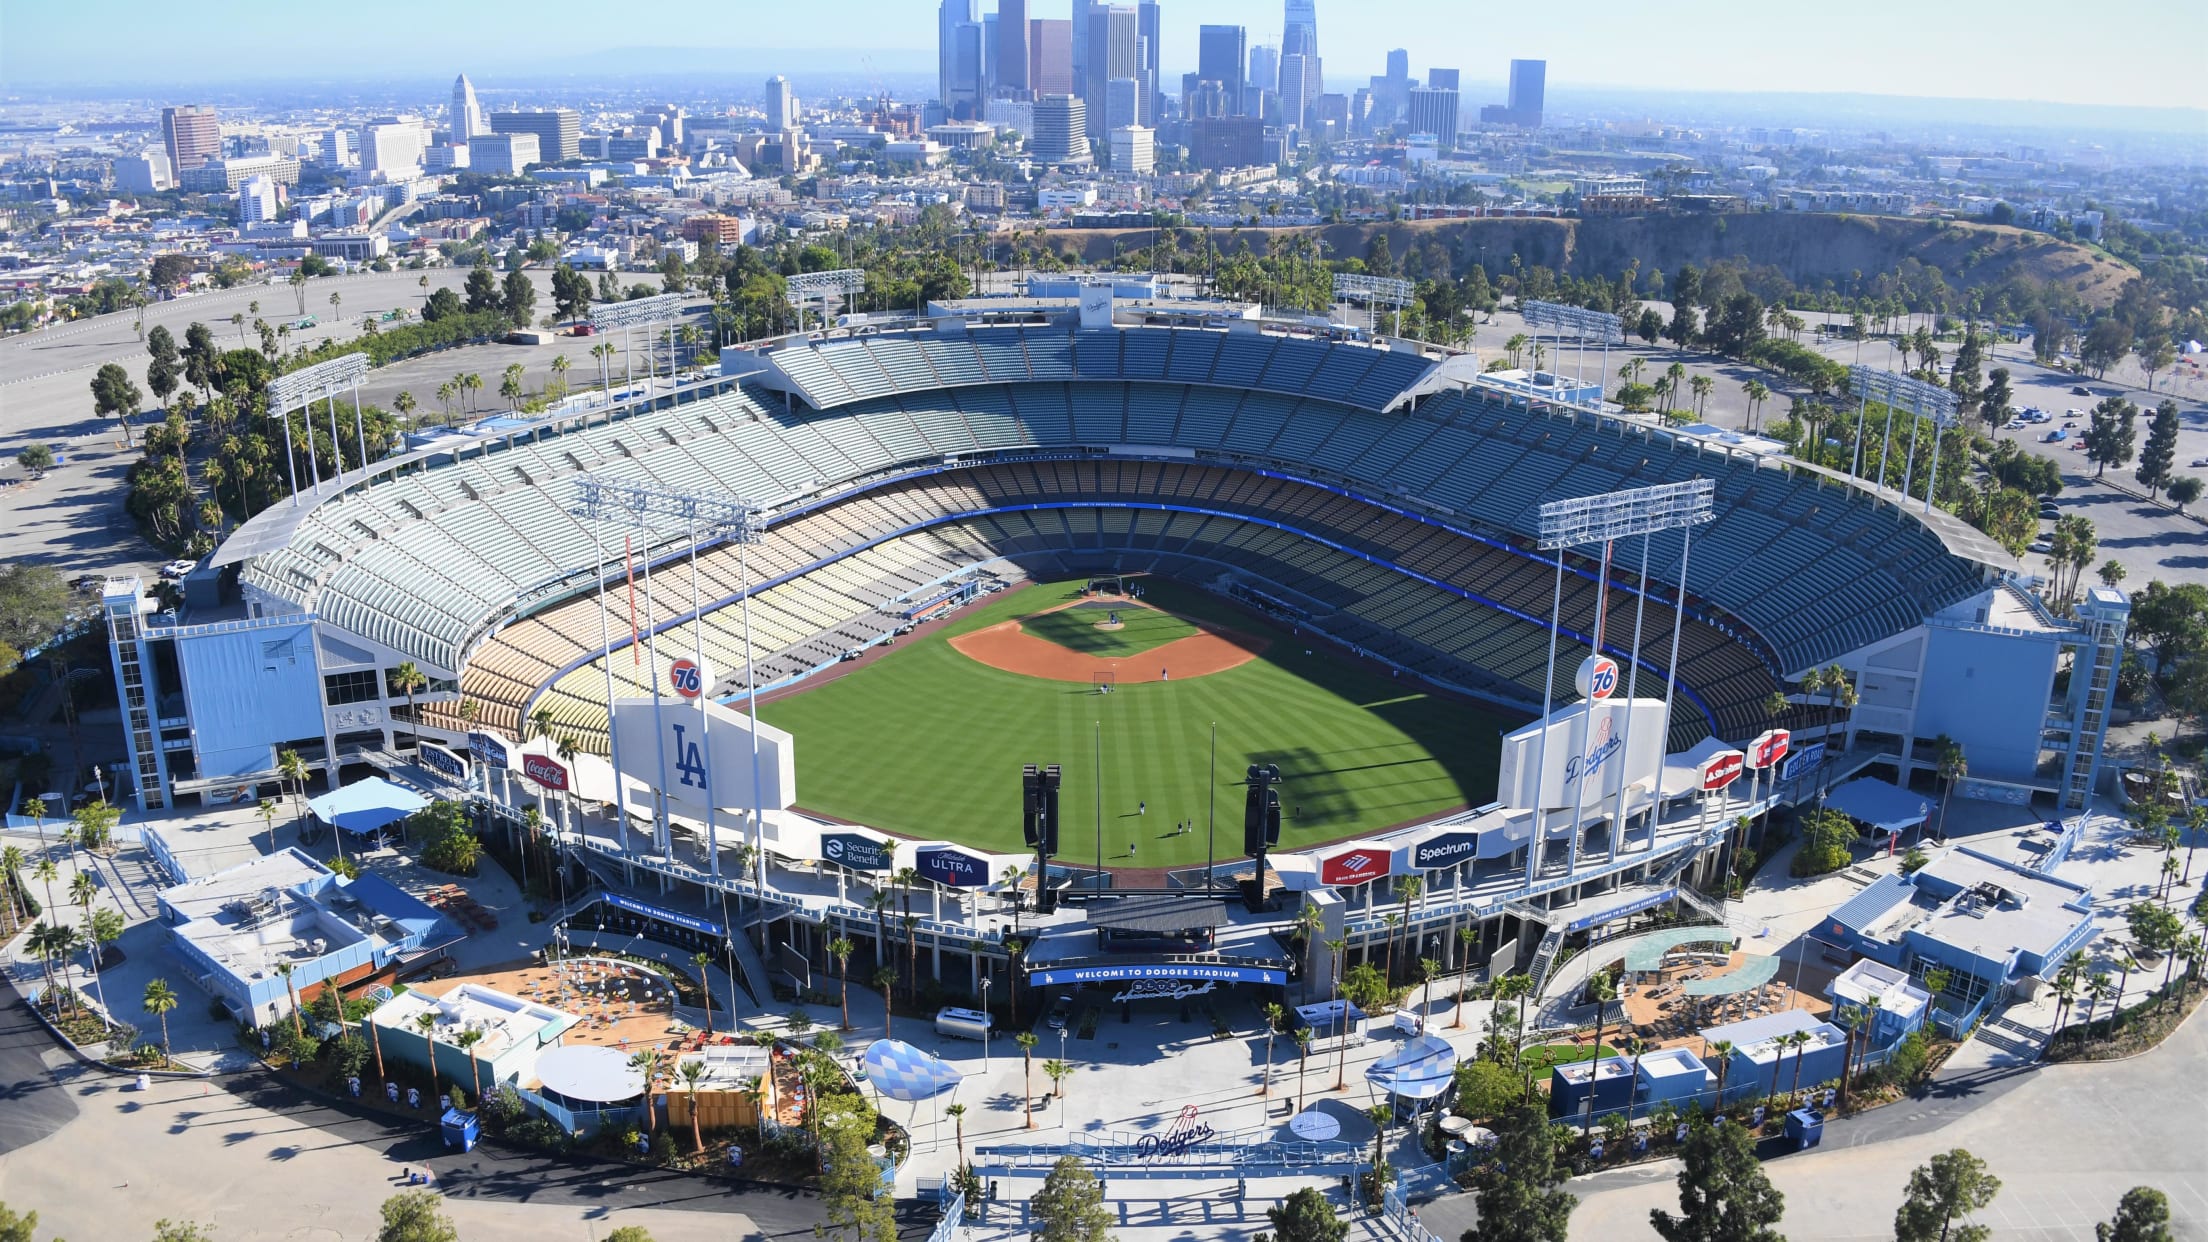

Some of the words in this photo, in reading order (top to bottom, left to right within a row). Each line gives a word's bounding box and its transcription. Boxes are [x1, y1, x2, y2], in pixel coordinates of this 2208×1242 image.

[674, 668, 700, 692] 76
[1593, 666, 1614, 693] 76
[672, 723, 707, 790] LA
[526, 759, 563, 786] Coca-Cola
[846, 841, 883, 858] Security
[847, 851, 880, 866] Benefit
[1419, 841, 1471, 861] Spectrum
[931, 858, 974, 874] ULTRA
[619, 899, 644, 911] WELCOME
[652, 909, 675, 920] DODGER
[676, 915, 701, 927] STADIUM
[1075, 969, 1124, 979] WELCOME
[1146, 968, 1189, 976] DODGER
[1193, 969, 1239, 978] STADIUM
[1135, 981, 1177, 990] BLUE
[1137, 1120, 1215, 1159] Dodgers
[1045, 1171, 1151, 1179] DGER
[1182, 1168, 1305, 1179] STADIUM
